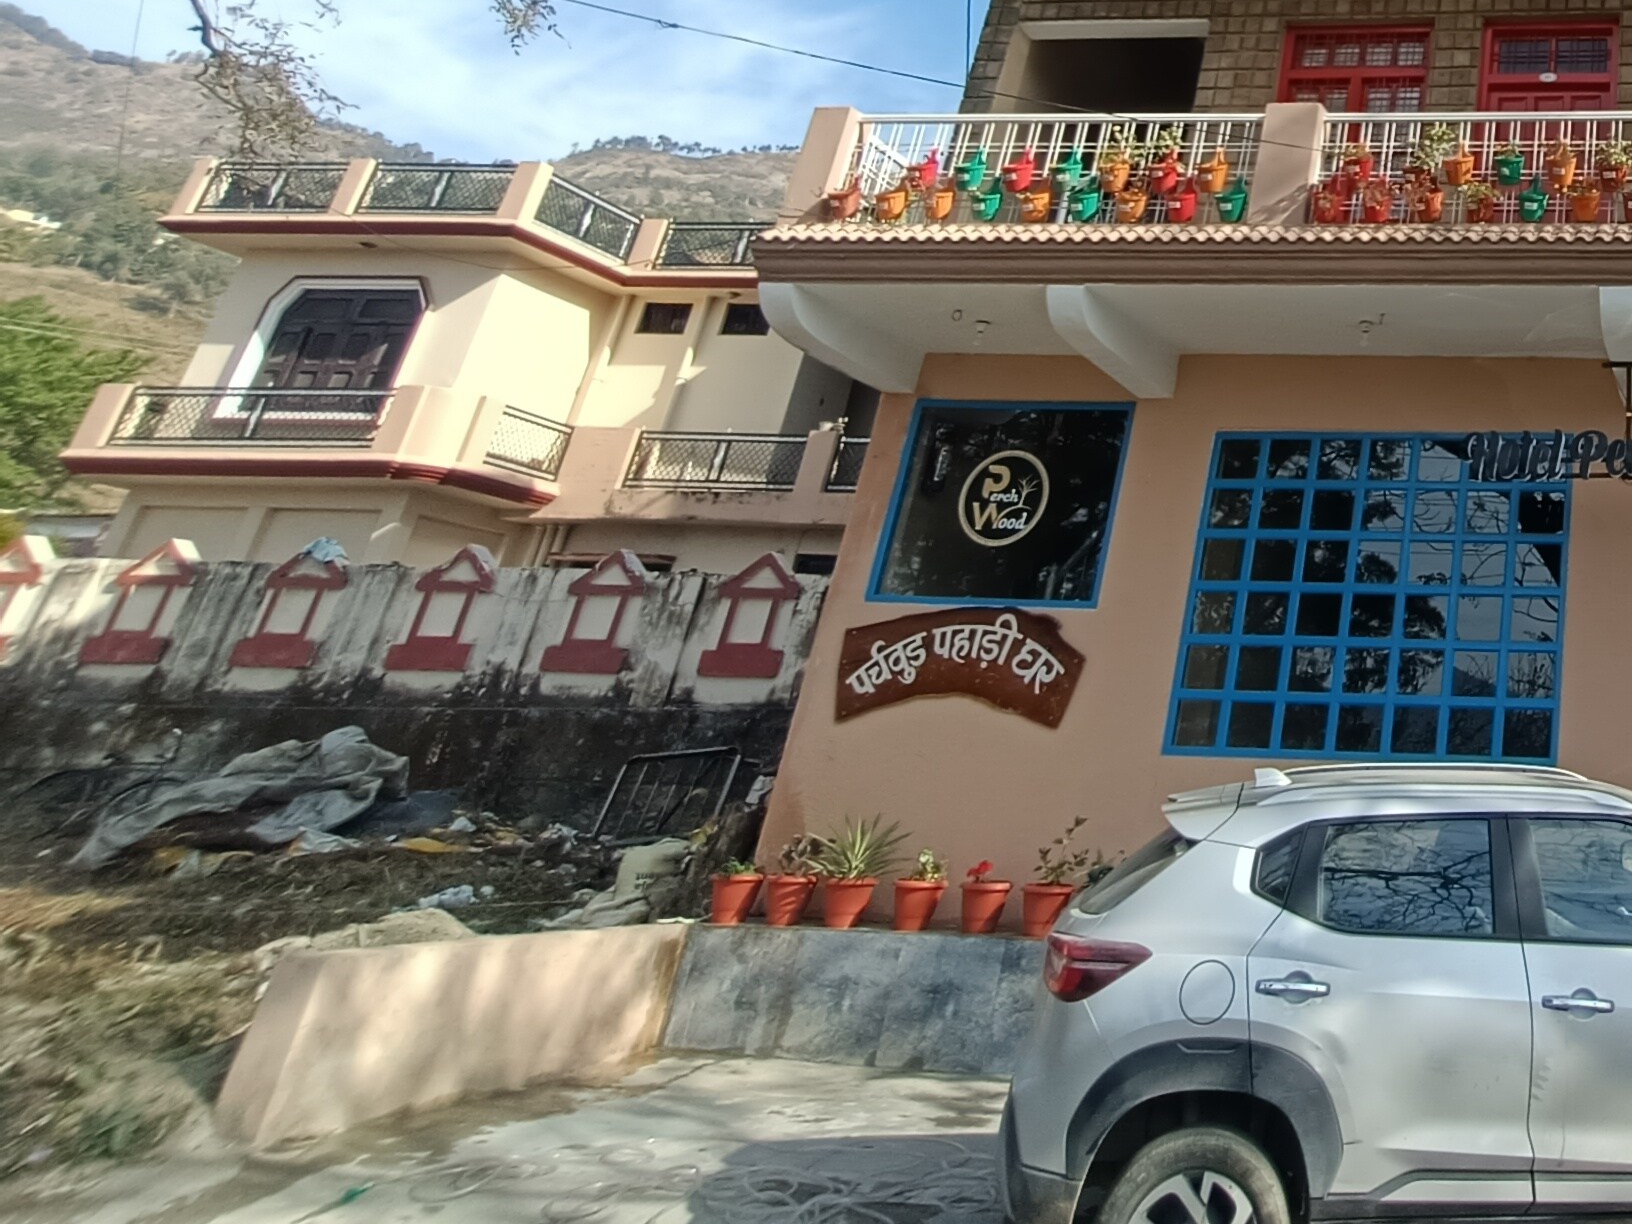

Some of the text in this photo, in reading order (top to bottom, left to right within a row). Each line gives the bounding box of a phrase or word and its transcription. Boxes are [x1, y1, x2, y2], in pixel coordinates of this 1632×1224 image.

[1466, 429, 1567, 482] Hotel
[981, 464, 1020, 503] Perch
[972, 501, 1028, 531] Wood
[845, 612, 1066, 695] पर्चवुड पहाड़ी घर
